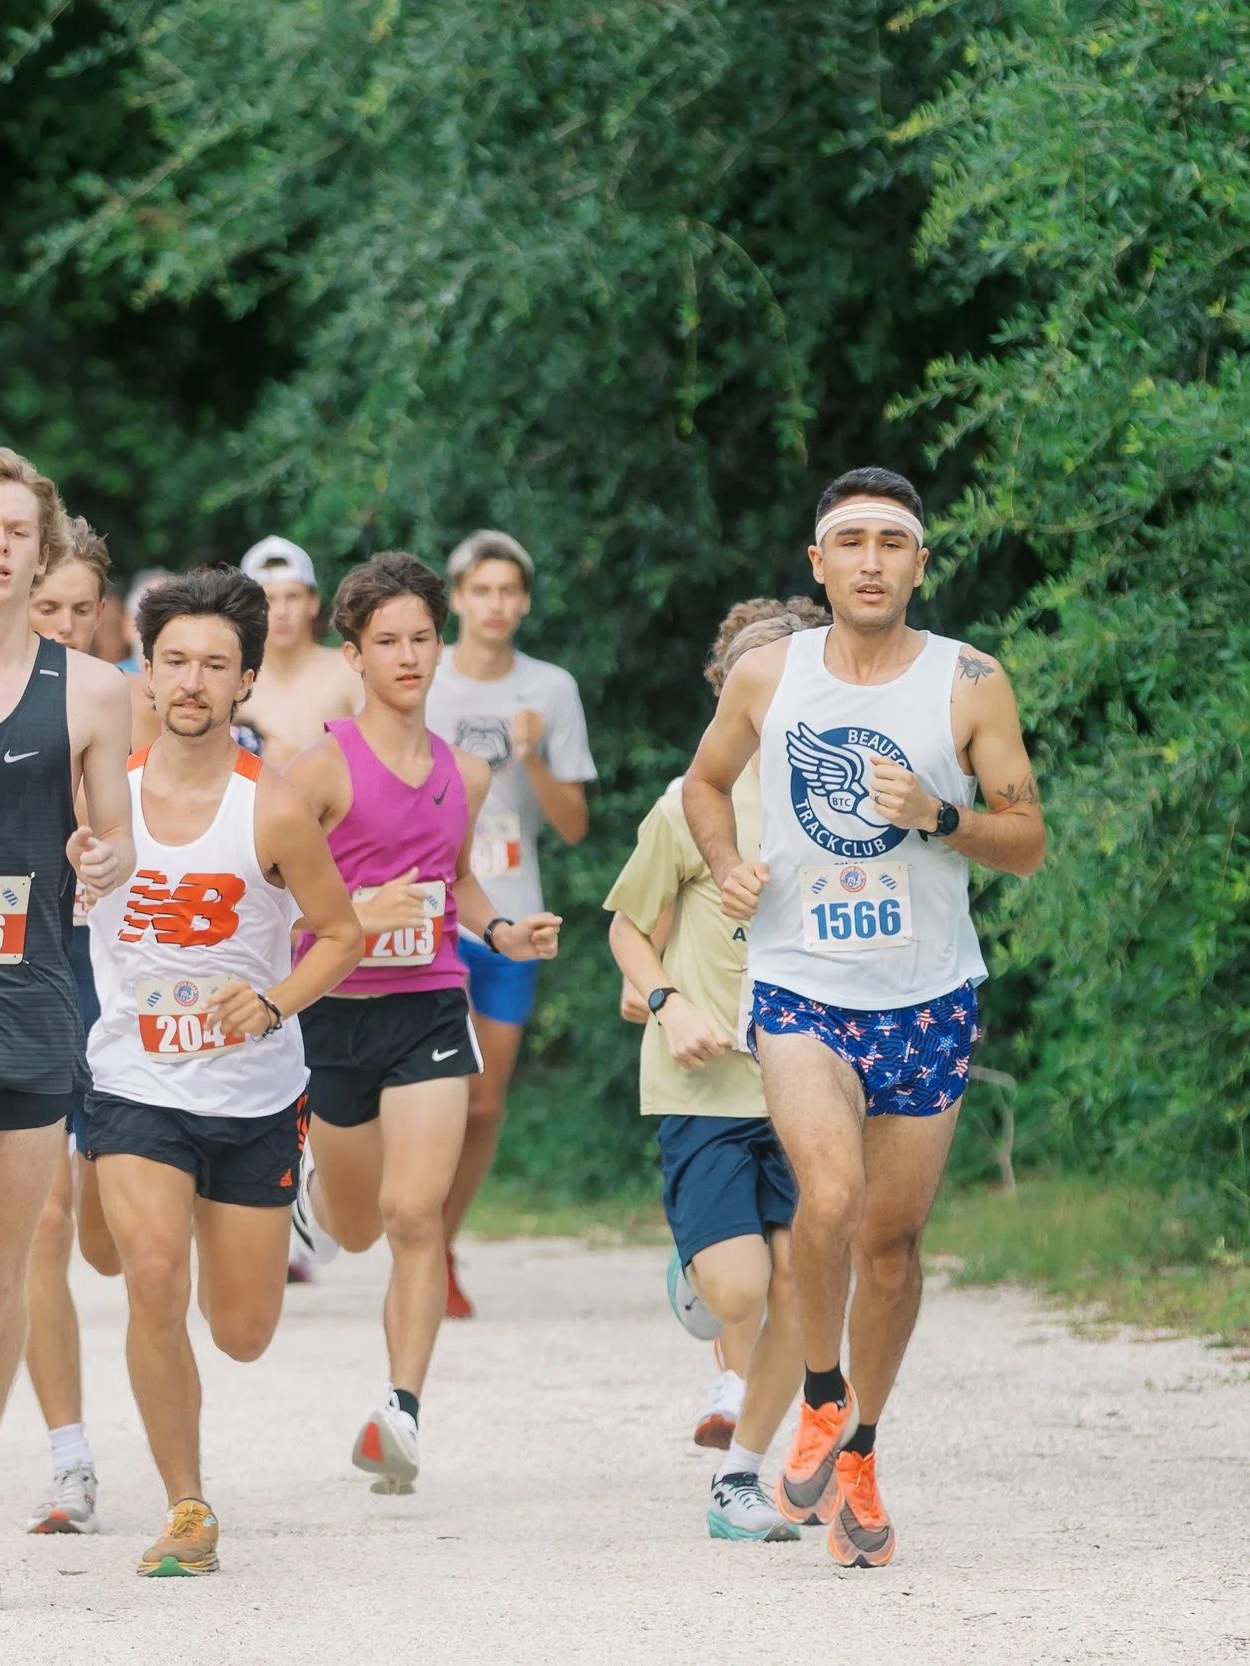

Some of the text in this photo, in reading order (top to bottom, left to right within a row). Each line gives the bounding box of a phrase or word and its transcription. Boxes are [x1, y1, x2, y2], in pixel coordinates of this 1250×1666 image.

[832, 797, 852, 807] BTC
[795, 798, 887, 856] TRACK CLUB
[373, 918, 435, 957] 203
[810, 898, 902, 941] 1566
[156, 1013, 227, 1053] 204
